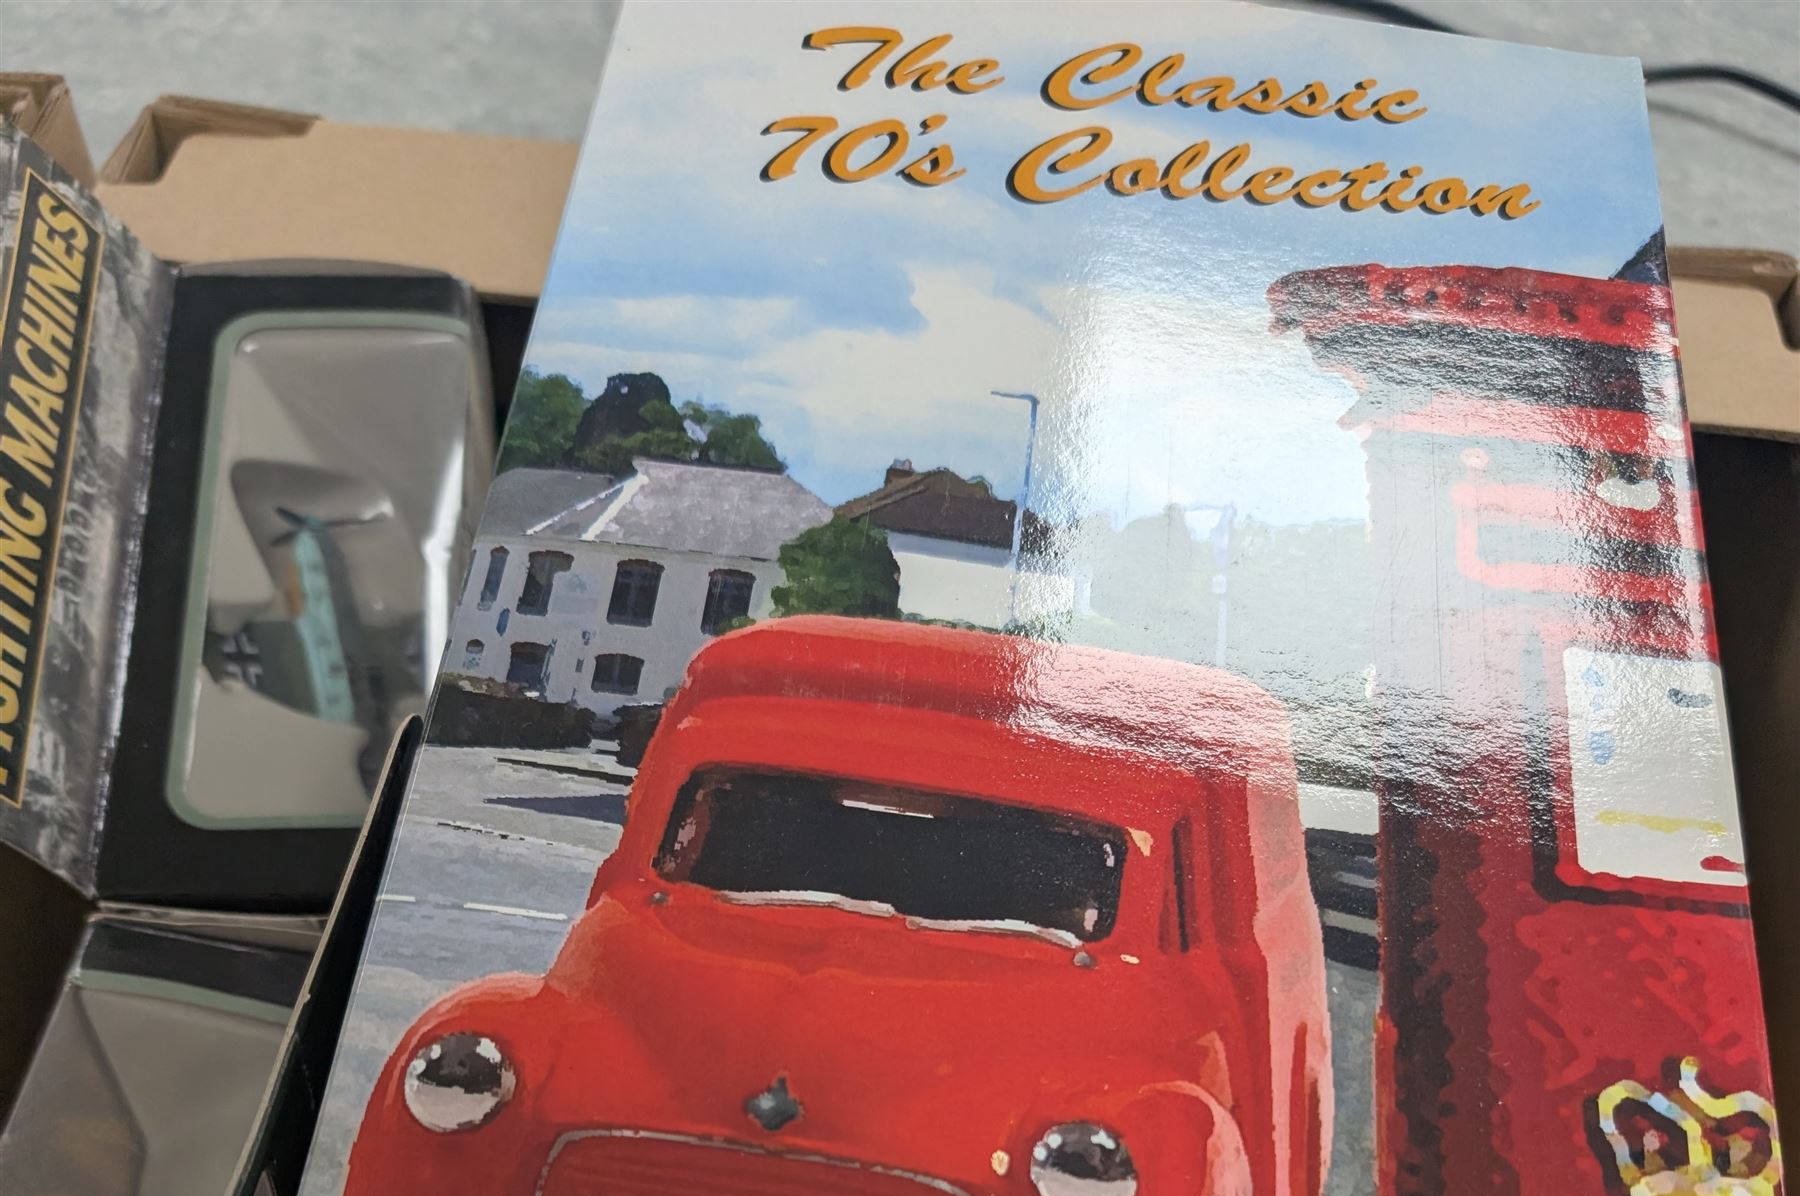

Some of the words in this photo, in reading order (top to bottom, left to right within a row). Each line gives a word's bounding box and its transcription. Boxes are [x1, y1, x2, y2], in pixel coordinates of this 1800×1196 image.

[803, 26, 1004, 94] The
[1041, 42, 1427, 124] Classic
[760, 114, 967, 187] 70's
[1006, 126, 1540, 220] Collection
[0, 193, 89, 488] MACHINES
